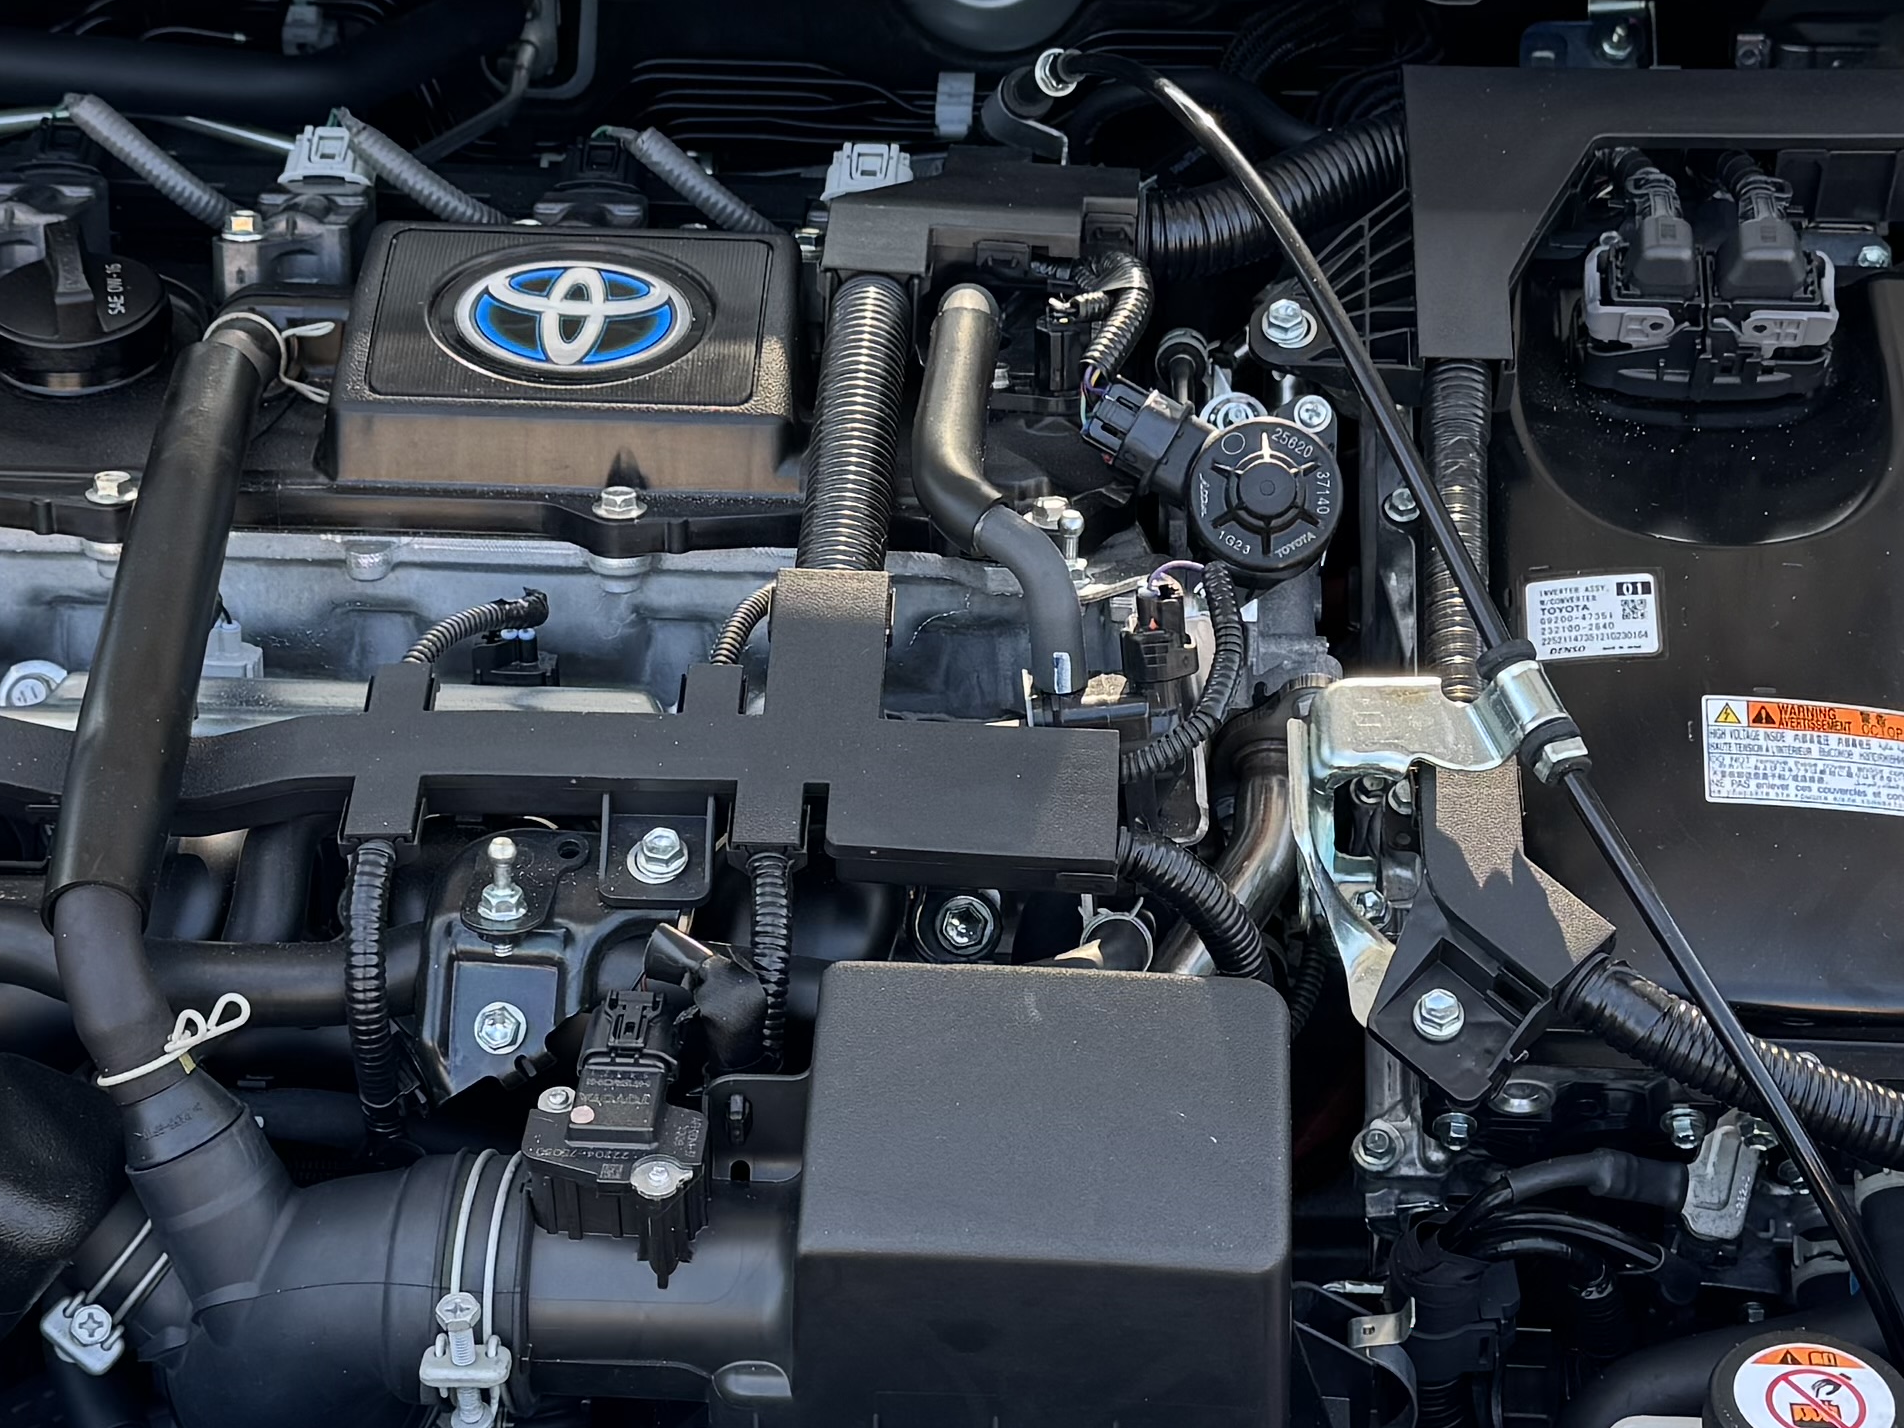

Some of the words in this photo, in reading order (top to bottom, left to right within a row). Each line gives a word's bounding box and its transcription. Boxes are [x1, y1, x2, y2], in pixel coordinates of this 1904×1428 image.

[107, 295, 125, 315] SAE
[1271, 428, 1314, 458] 25620
[1316, 472, 1331, 515] 37140
[1218, 530, 1251, 554] 1G23
[1274, 531, 1317, 558] TOYOTA
[1623, 583, 1643, 595] 01
[1540, 604, 1590, 616] TOYOTA
[1550, 645, 1586, 655] DENSO
[1778, 703, 1836, 720] WARNING
[1779, 719, 1851, 734] AVERTISSEMENT
